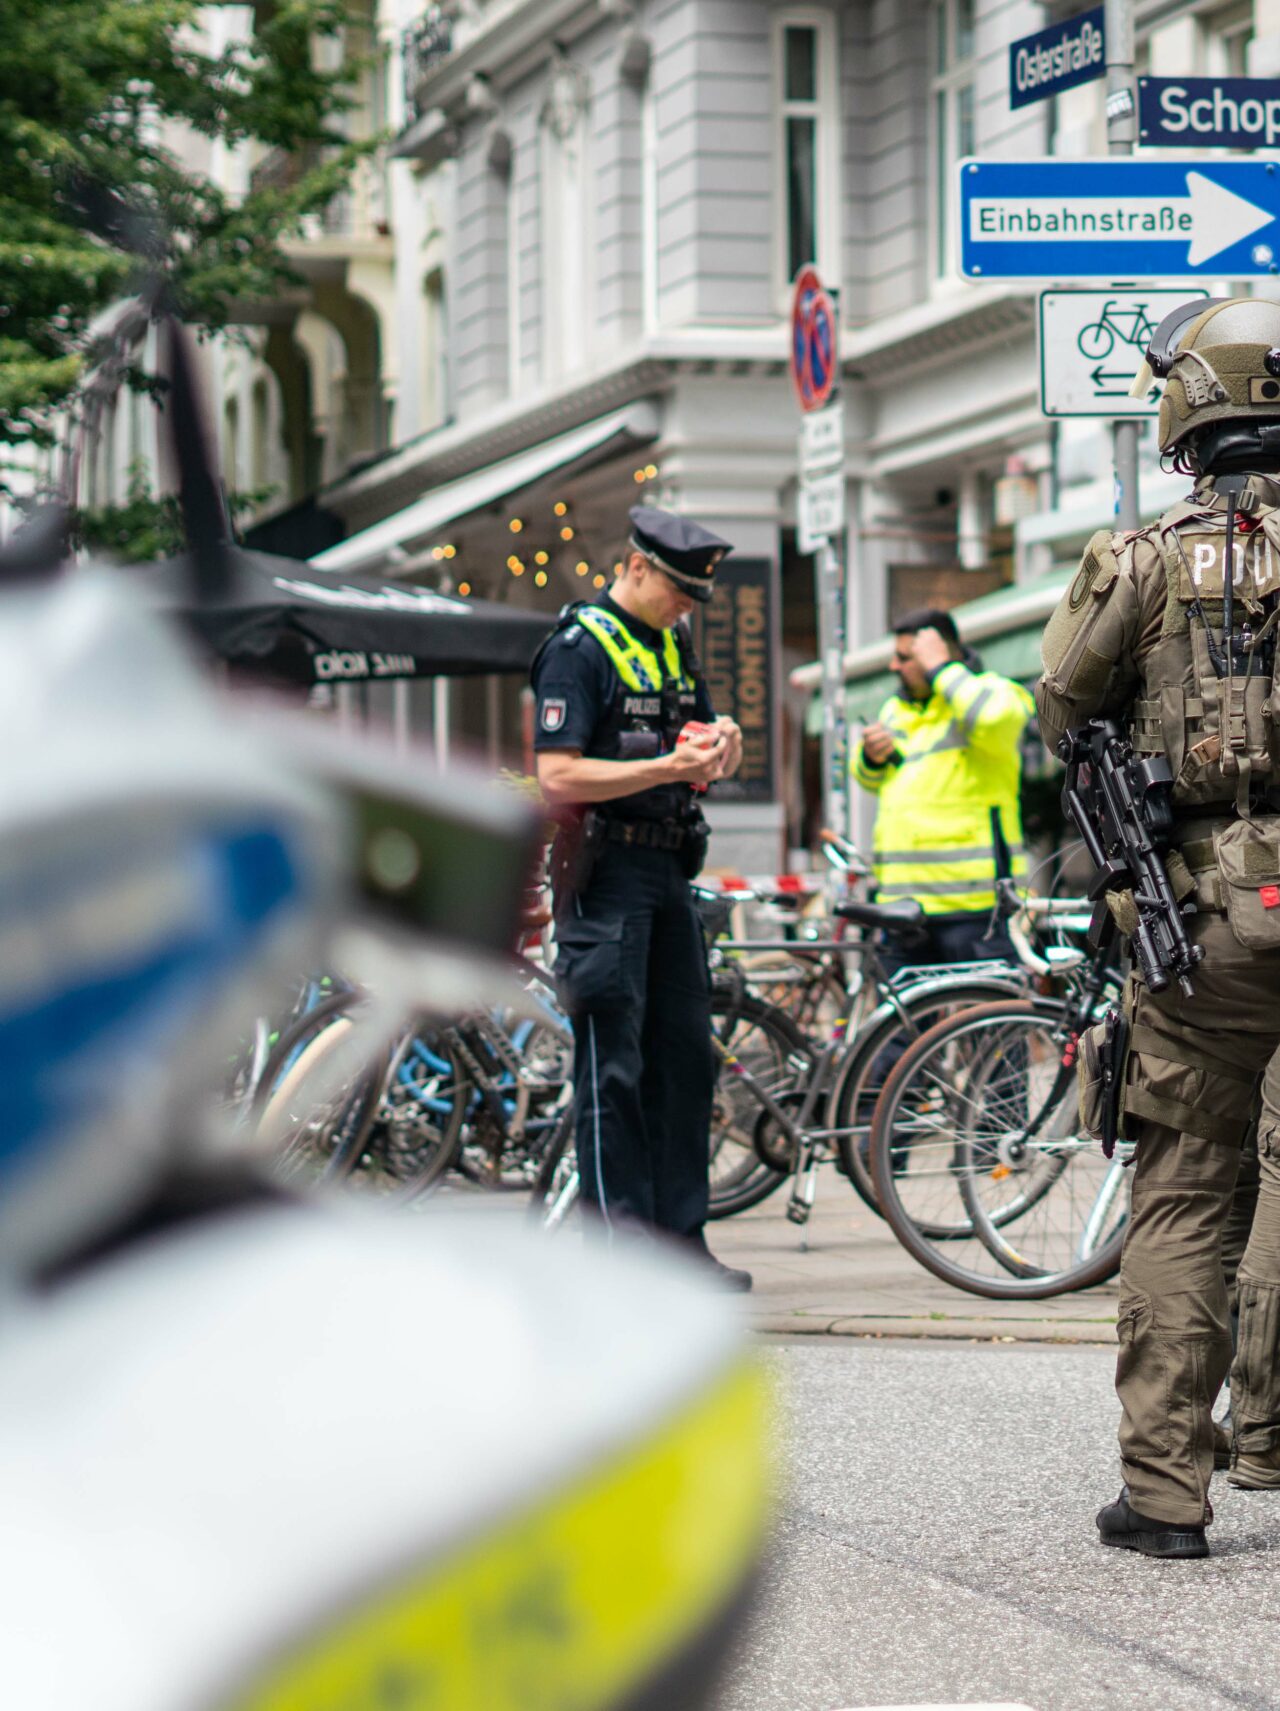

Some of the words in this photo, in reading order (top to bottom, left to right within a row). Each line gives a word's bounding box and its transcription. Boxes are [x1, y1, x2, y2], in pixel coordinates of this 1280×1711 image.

[1016, 21, 1102, 92] Osterstraße
[979, 206, 1193, 232] Einbahnstraße
[736, 585, 766, 727] KONTOR
